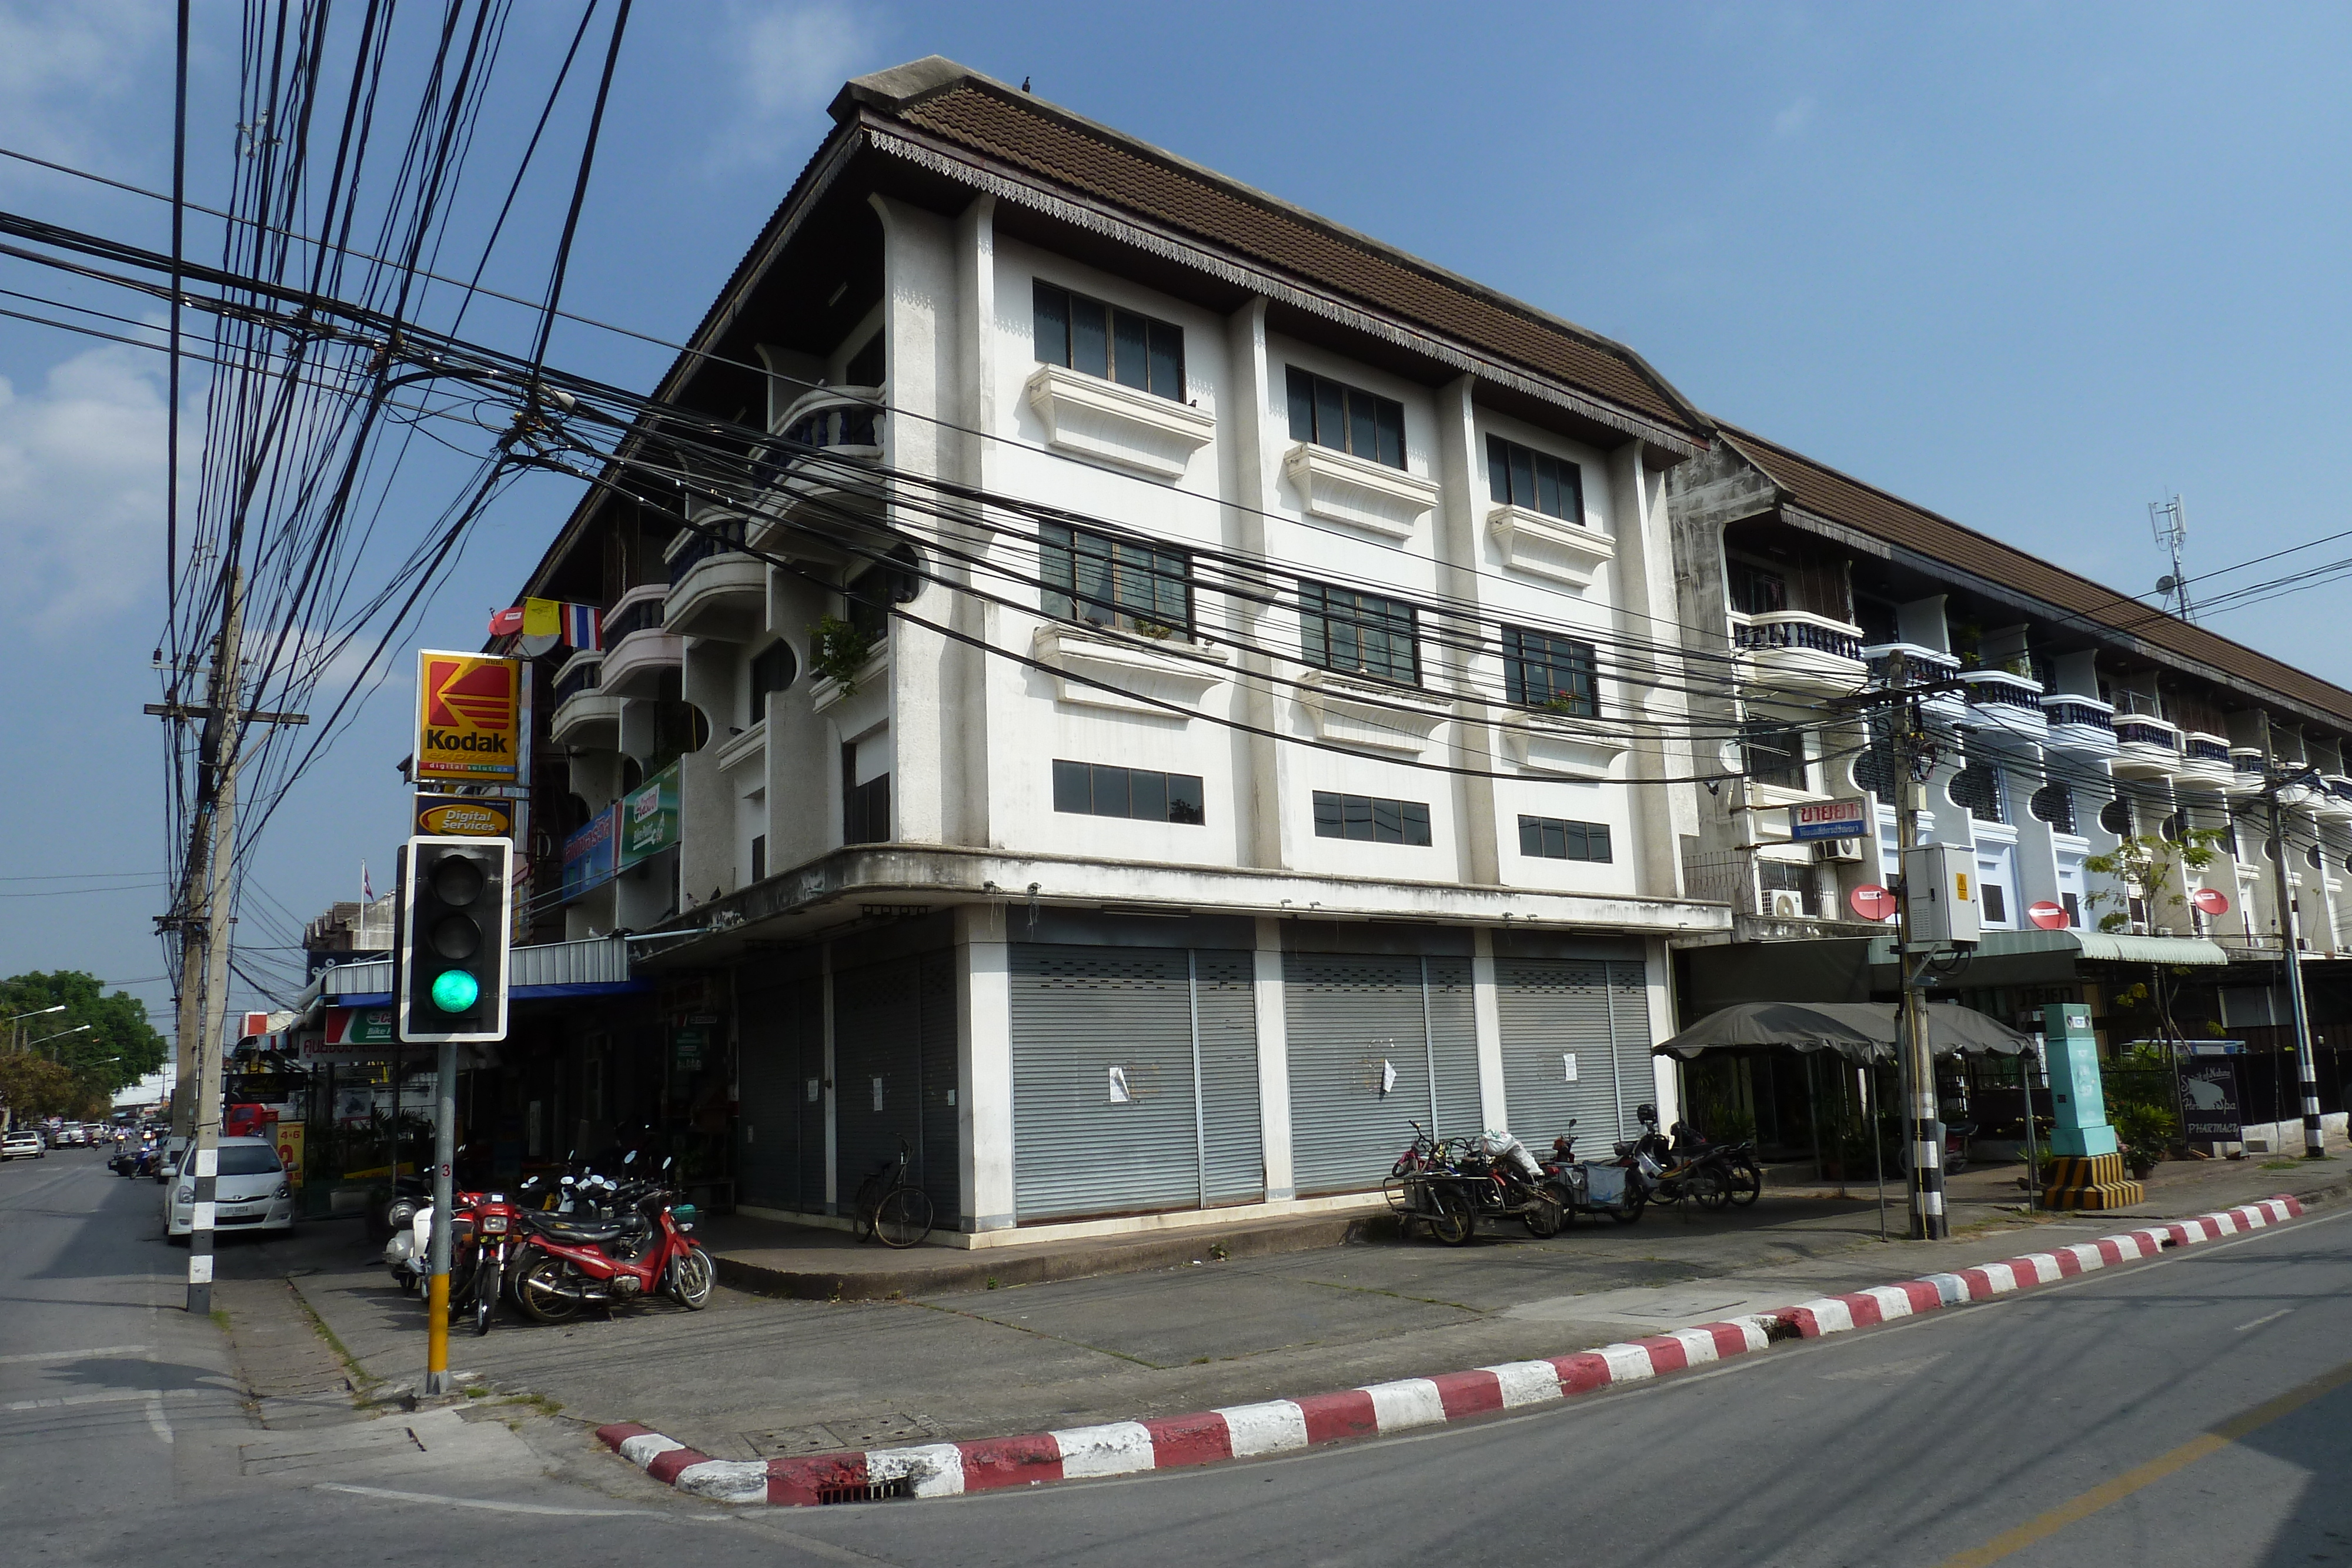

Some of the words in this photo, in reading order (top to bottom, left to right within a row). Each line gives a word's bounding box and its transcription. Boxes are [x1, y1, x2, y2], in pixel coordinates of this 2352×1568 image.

[427, 730, 507, 753] Kodak
[428, 752, 507, 762] express
[446, 810, 492, 822] Digital
[442, 820, 496, 831] Services
[2188, 1123, 2239, 1138] PHARMACY
[442, 1164, 450, 1177] 3
